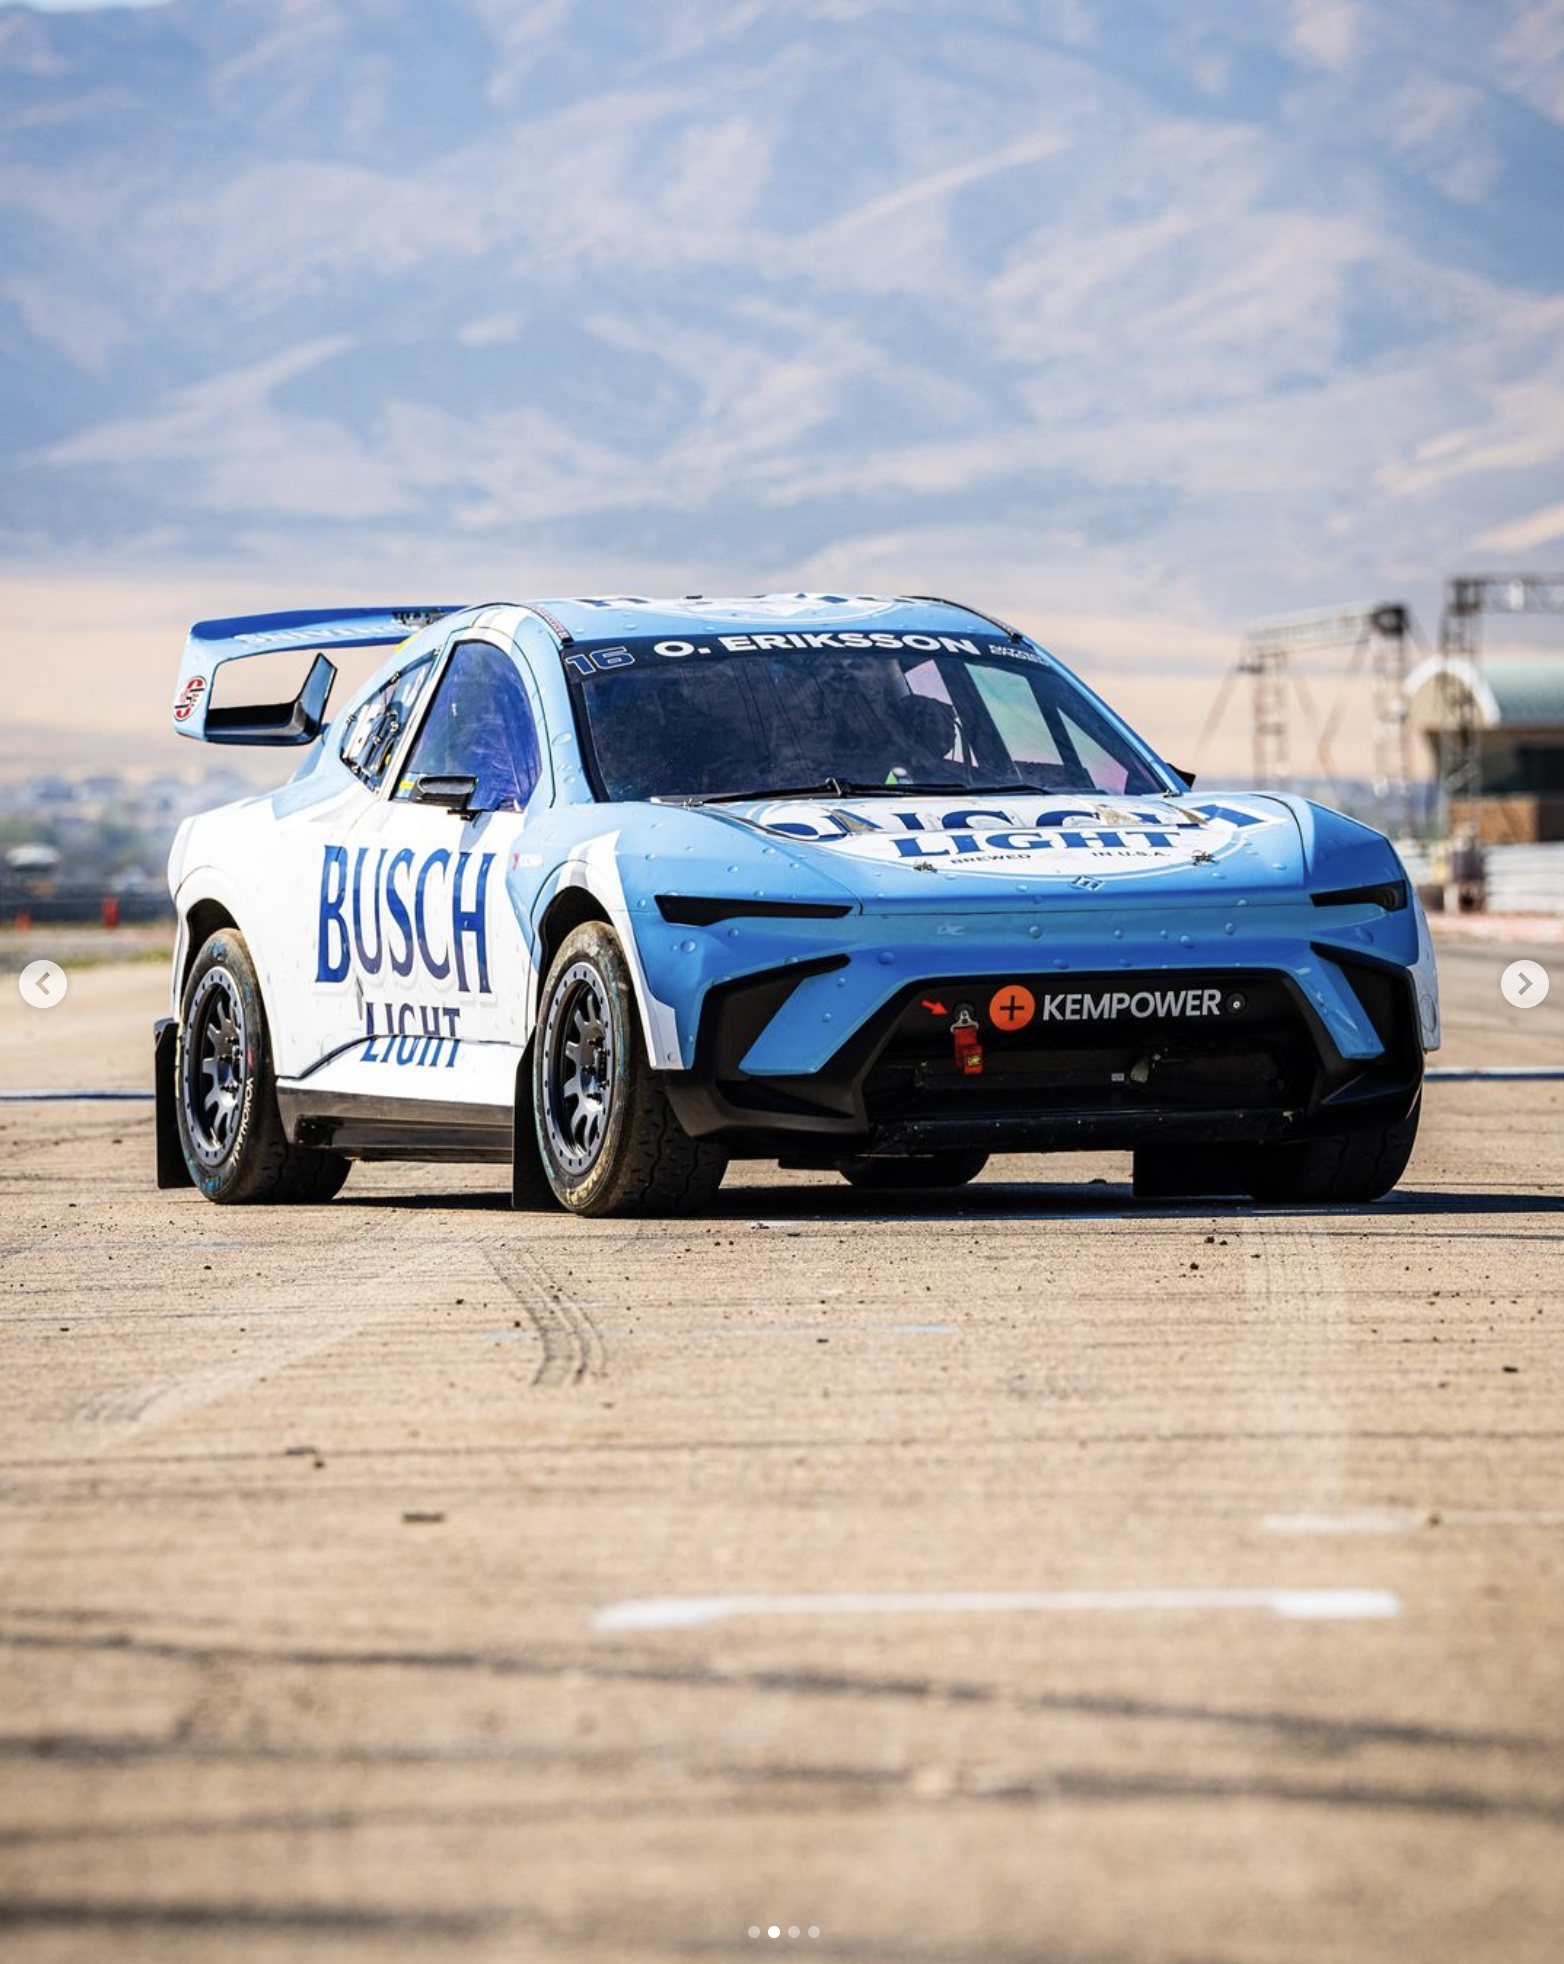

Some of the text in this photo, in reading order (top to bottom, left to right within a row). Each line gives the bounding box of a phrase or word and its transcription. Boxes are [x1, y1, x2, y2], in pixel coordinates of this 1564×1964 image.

[653, 633, 982, 657] O. ERIKSSON
[565, 646, 636, 675] 16
[889, 831, 1181, 858] LIGHT
[950, 853, 1032, 865] BREWED
[314, 844, 497, 994] BUSCH
[1043, 989, 1222, 1021] KEMPOWER
[359, 1002, 462, 1068] LIGHT
